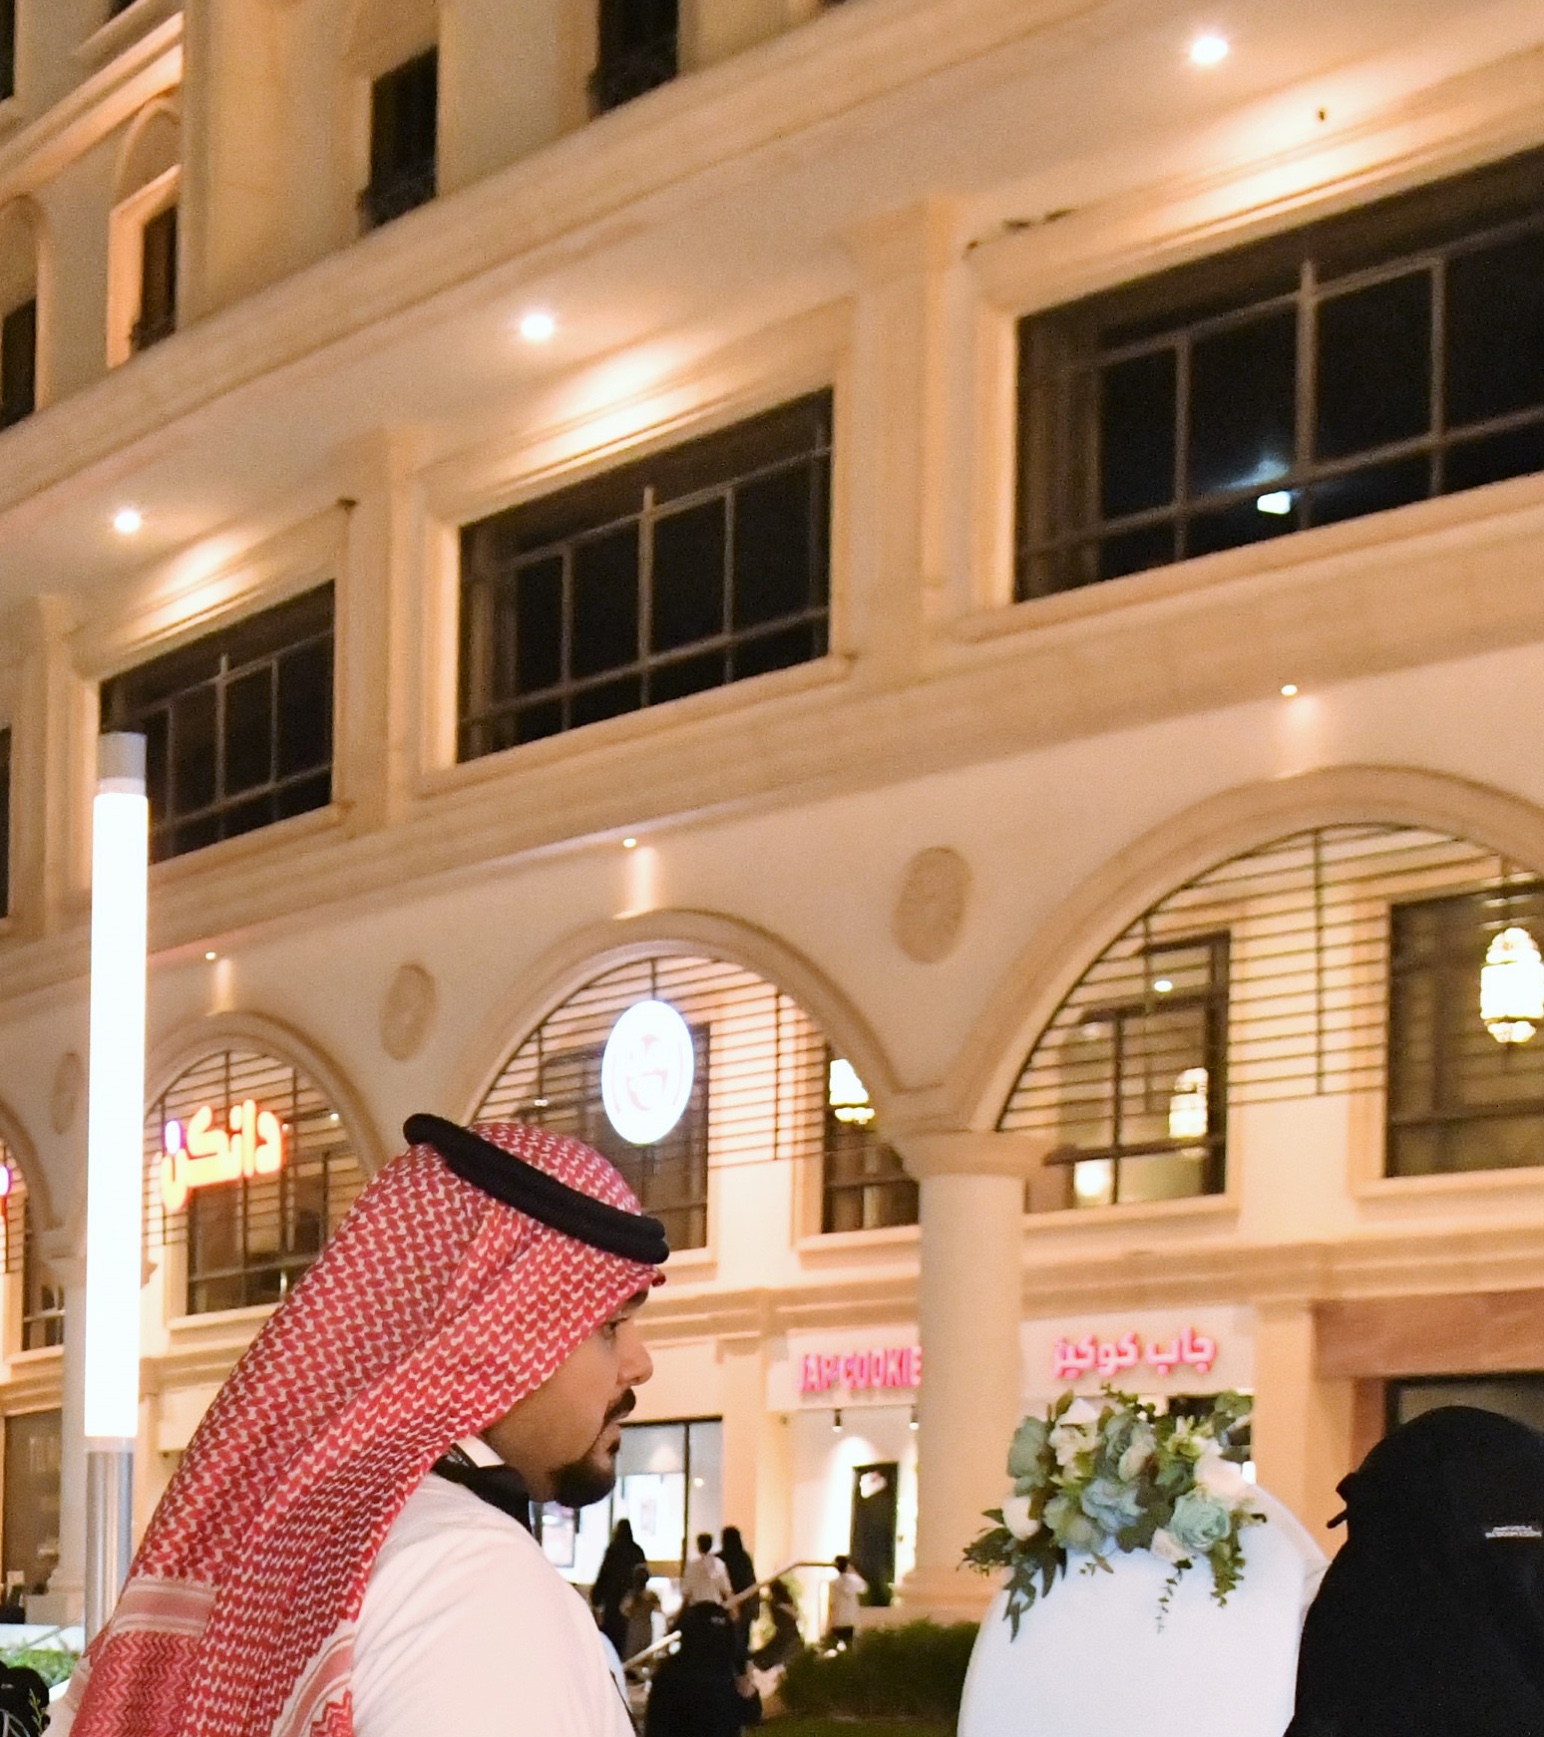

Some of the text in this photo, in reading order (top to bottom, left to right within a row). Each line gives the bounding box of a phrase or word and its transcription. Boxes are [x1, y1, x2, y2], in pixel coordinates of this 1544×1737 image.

[158, 1098, 283, 1213] دانكن
[839, 1345, 923, 1390] COOKIE
[1051, 1327, 1217, 1380] جاب كوكيز
